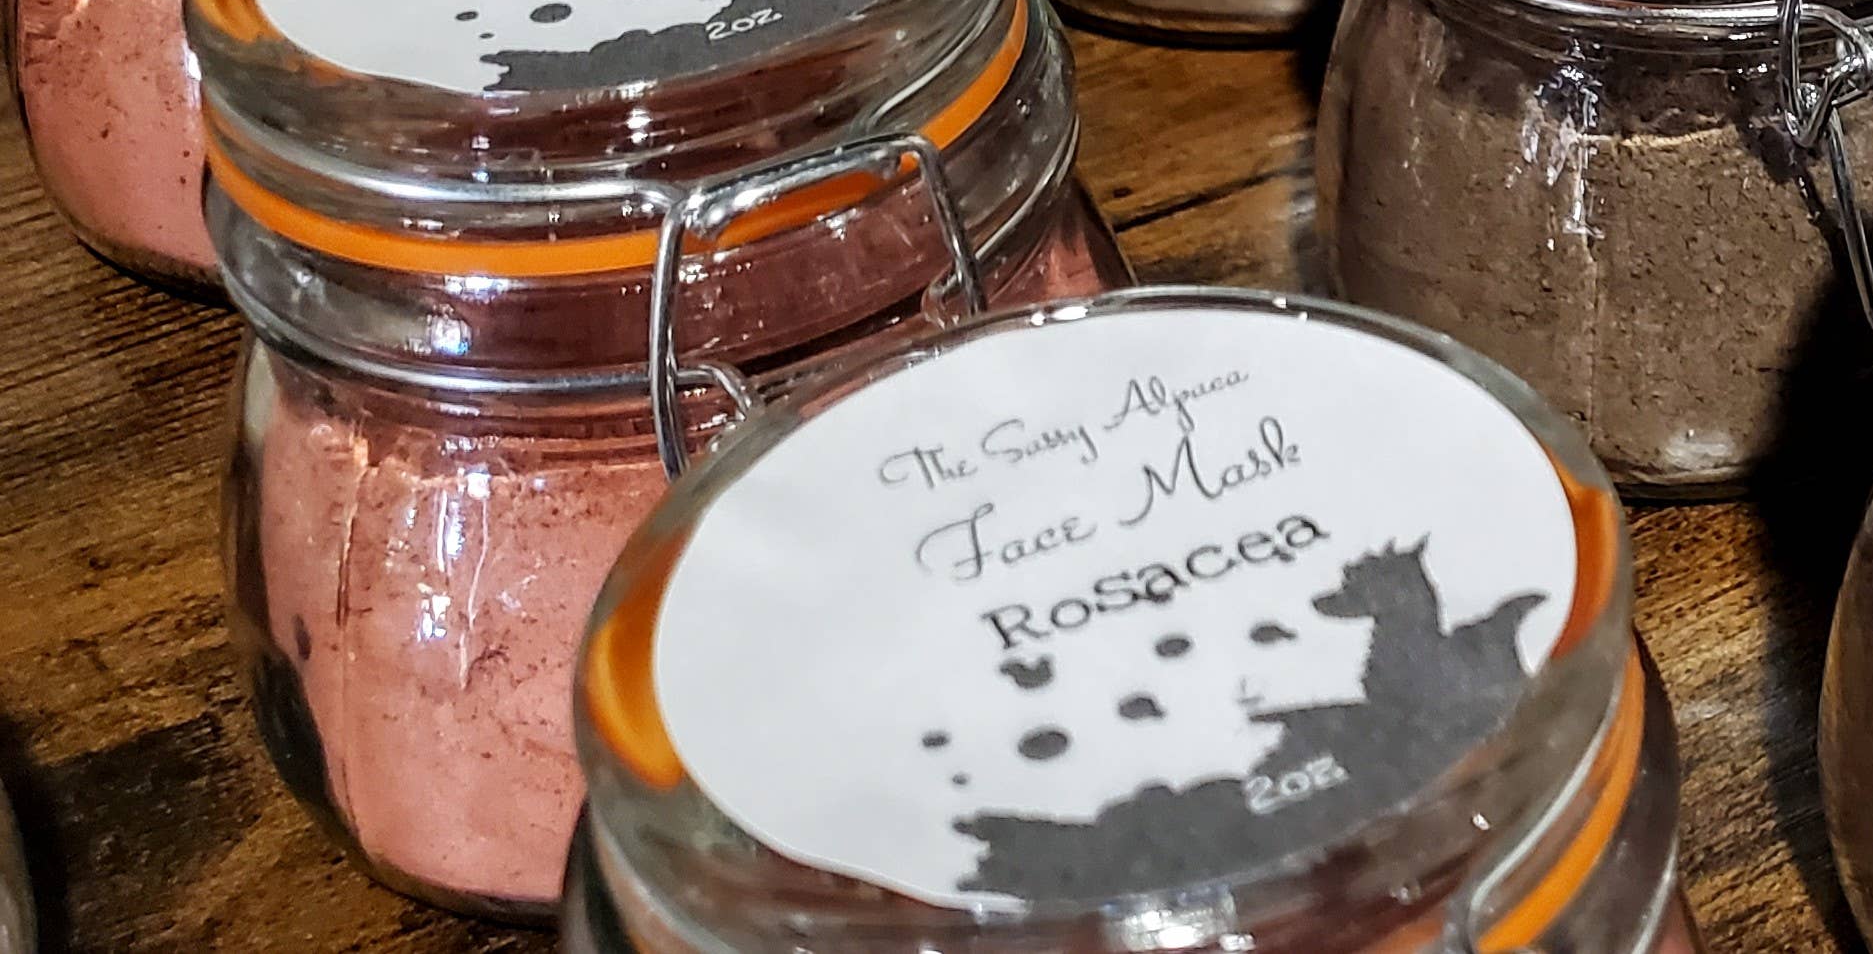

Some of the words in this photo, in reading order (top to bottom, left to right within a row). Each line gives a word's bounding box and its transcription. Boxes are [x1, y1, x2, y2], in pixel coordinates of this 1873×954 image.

[704, 7, 784, 41] 2oz
[879, 446, 979, 489] The
[979, 417, 1099, 466] Sassy
[1102, 368, 1250, 433] Alpaca
[914, 501, 1098, 582] Face
[1117, 415, 1302, 527] Mask
[977, 512, 1333, 650] Rosacea
[1245, 754, 1351, 816] 2oz
